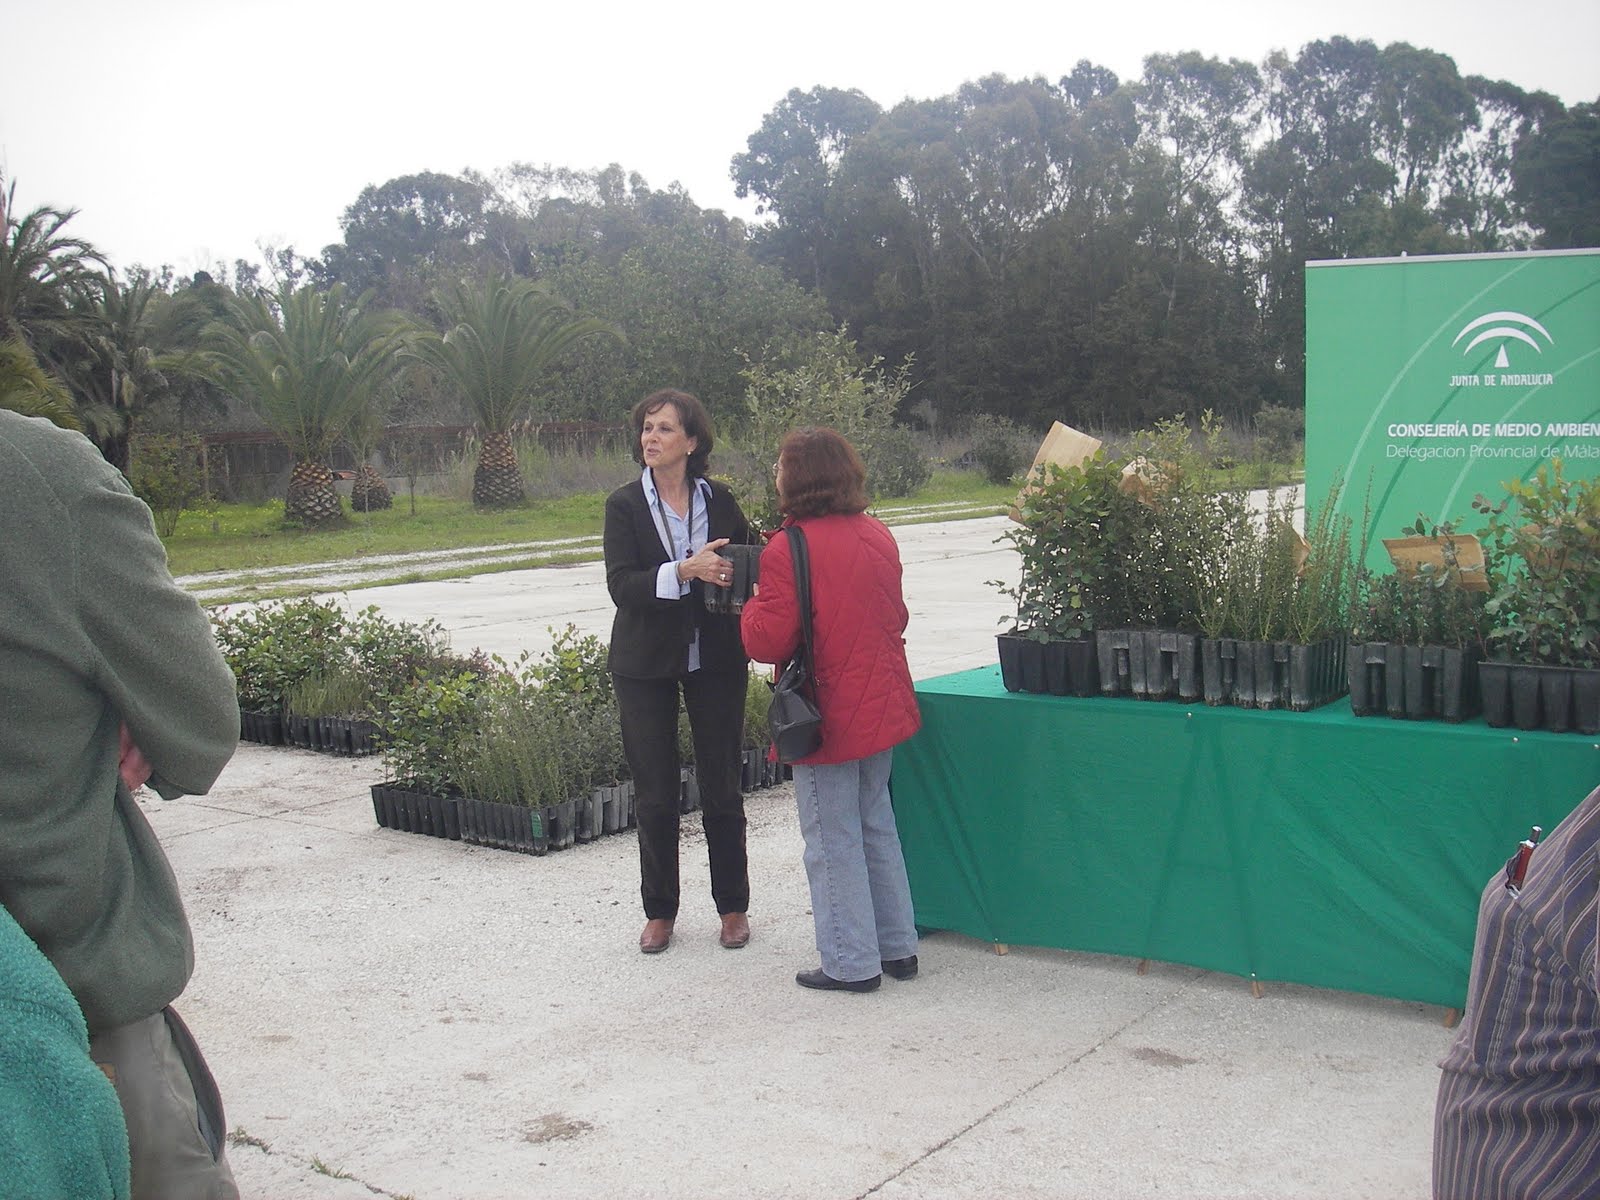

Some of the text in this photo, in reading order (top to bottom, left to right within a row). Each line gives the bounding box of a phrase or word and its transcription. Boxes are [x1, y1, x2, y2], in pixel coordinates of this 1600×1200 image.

[1449, 375, 1480, 387] JUNTA
[1484, 374, 1496, 386] DE
[1387, 420, 1469, 438] CONSEJERÍA
[1471, 423, 1491, 437] DE
[1494, 423, 1542, 437] MEDIO
[1386, 444, 1466, 462] Delegacion
[1469, 444, 1537, 459] Provincial
[1540, 444, 1560, 458] de
